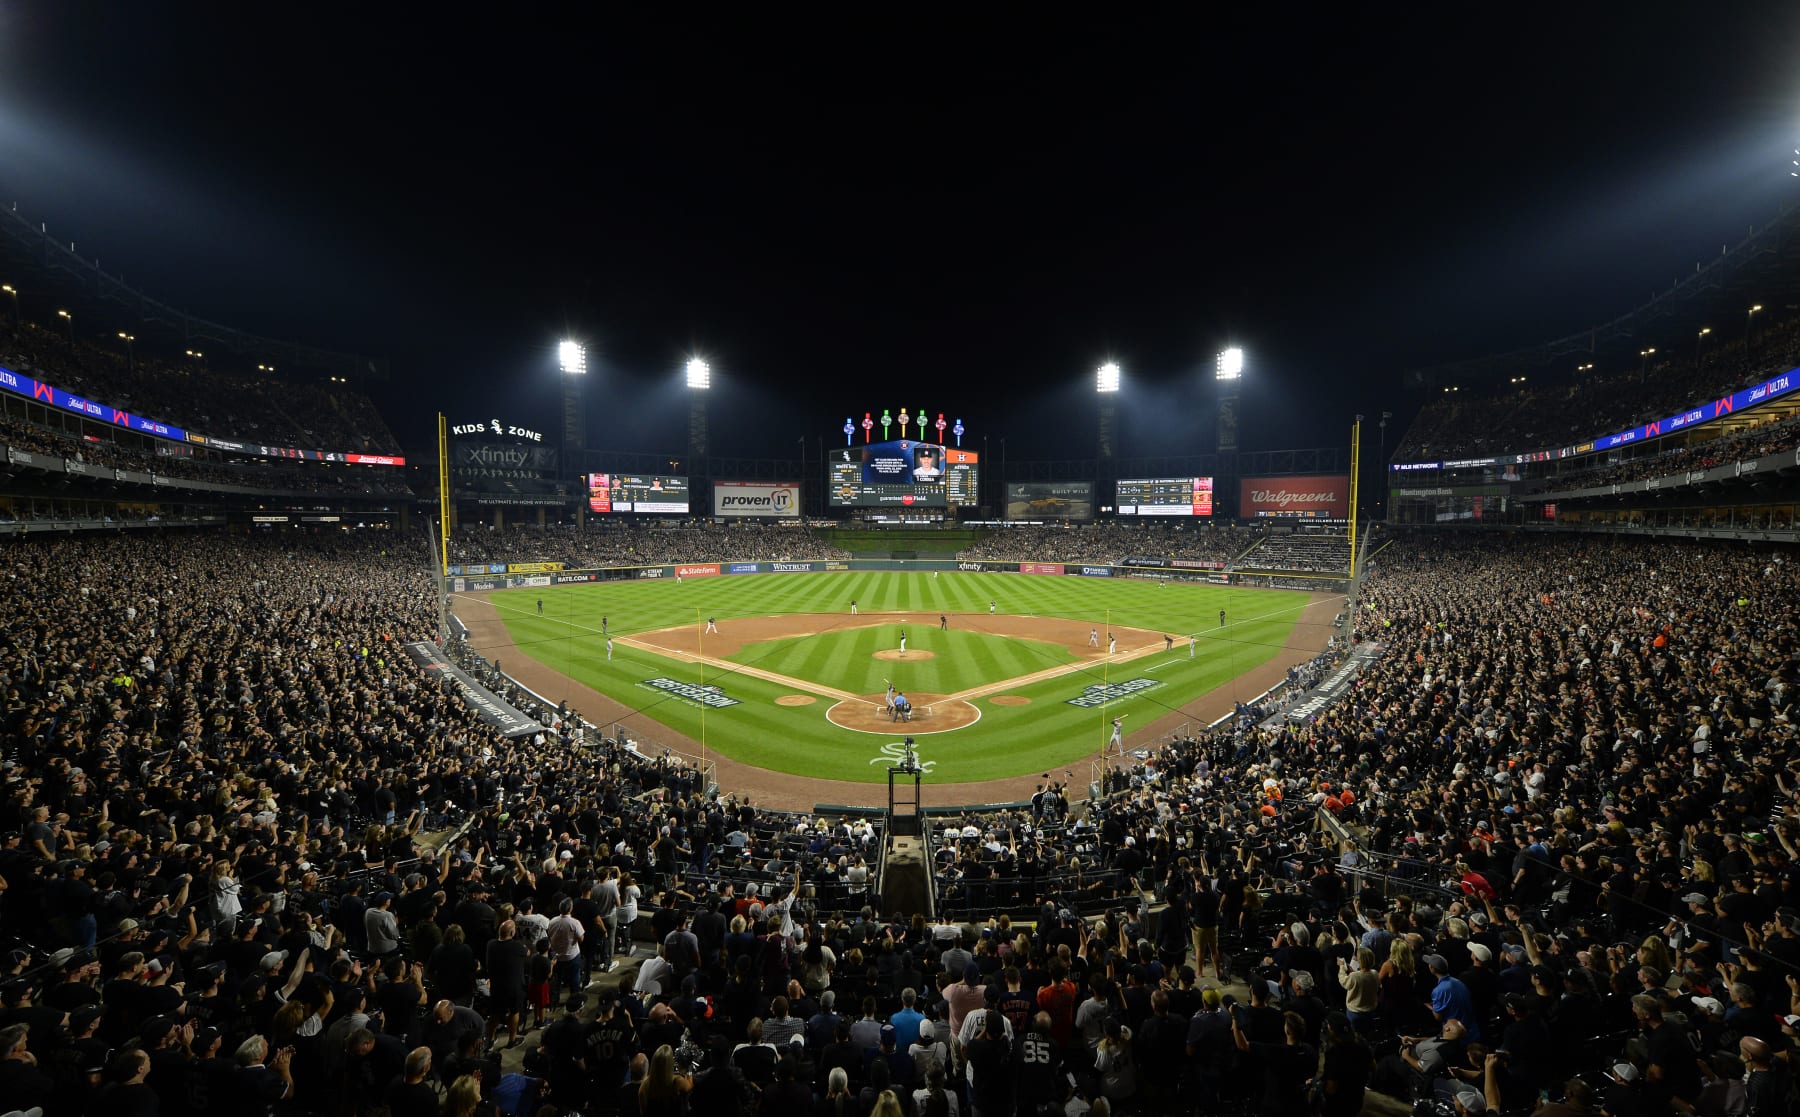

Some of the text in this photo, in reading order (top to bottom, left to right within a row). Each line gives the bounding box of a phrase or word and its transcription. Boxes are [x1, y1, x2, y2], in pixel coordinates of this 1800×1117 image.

[1769, 377, 1789, 393] ULTRA
[452, 423, 485, 435] KIDS
[508, 425, 543, 442] ZONE
[470, 446, 529, 467] xfinity
[722, 495, 788, 506] proven IT
[1250, 489, 1336, 507] Walgreens
[1400, 488, 1437, 497] Huntington
[773, 562, 811, 571] WINTRUST
[958, 562, 981, 572] xfinity
[474, 582, 494, 590] Modelo
[557, 575, 588, 583] RATE.COM
[644, 677, 739, 708] POSTSEASON
[1067, 678, 1159, 708] POSTSEASON
[594, 1041, 614, 1061] 10
